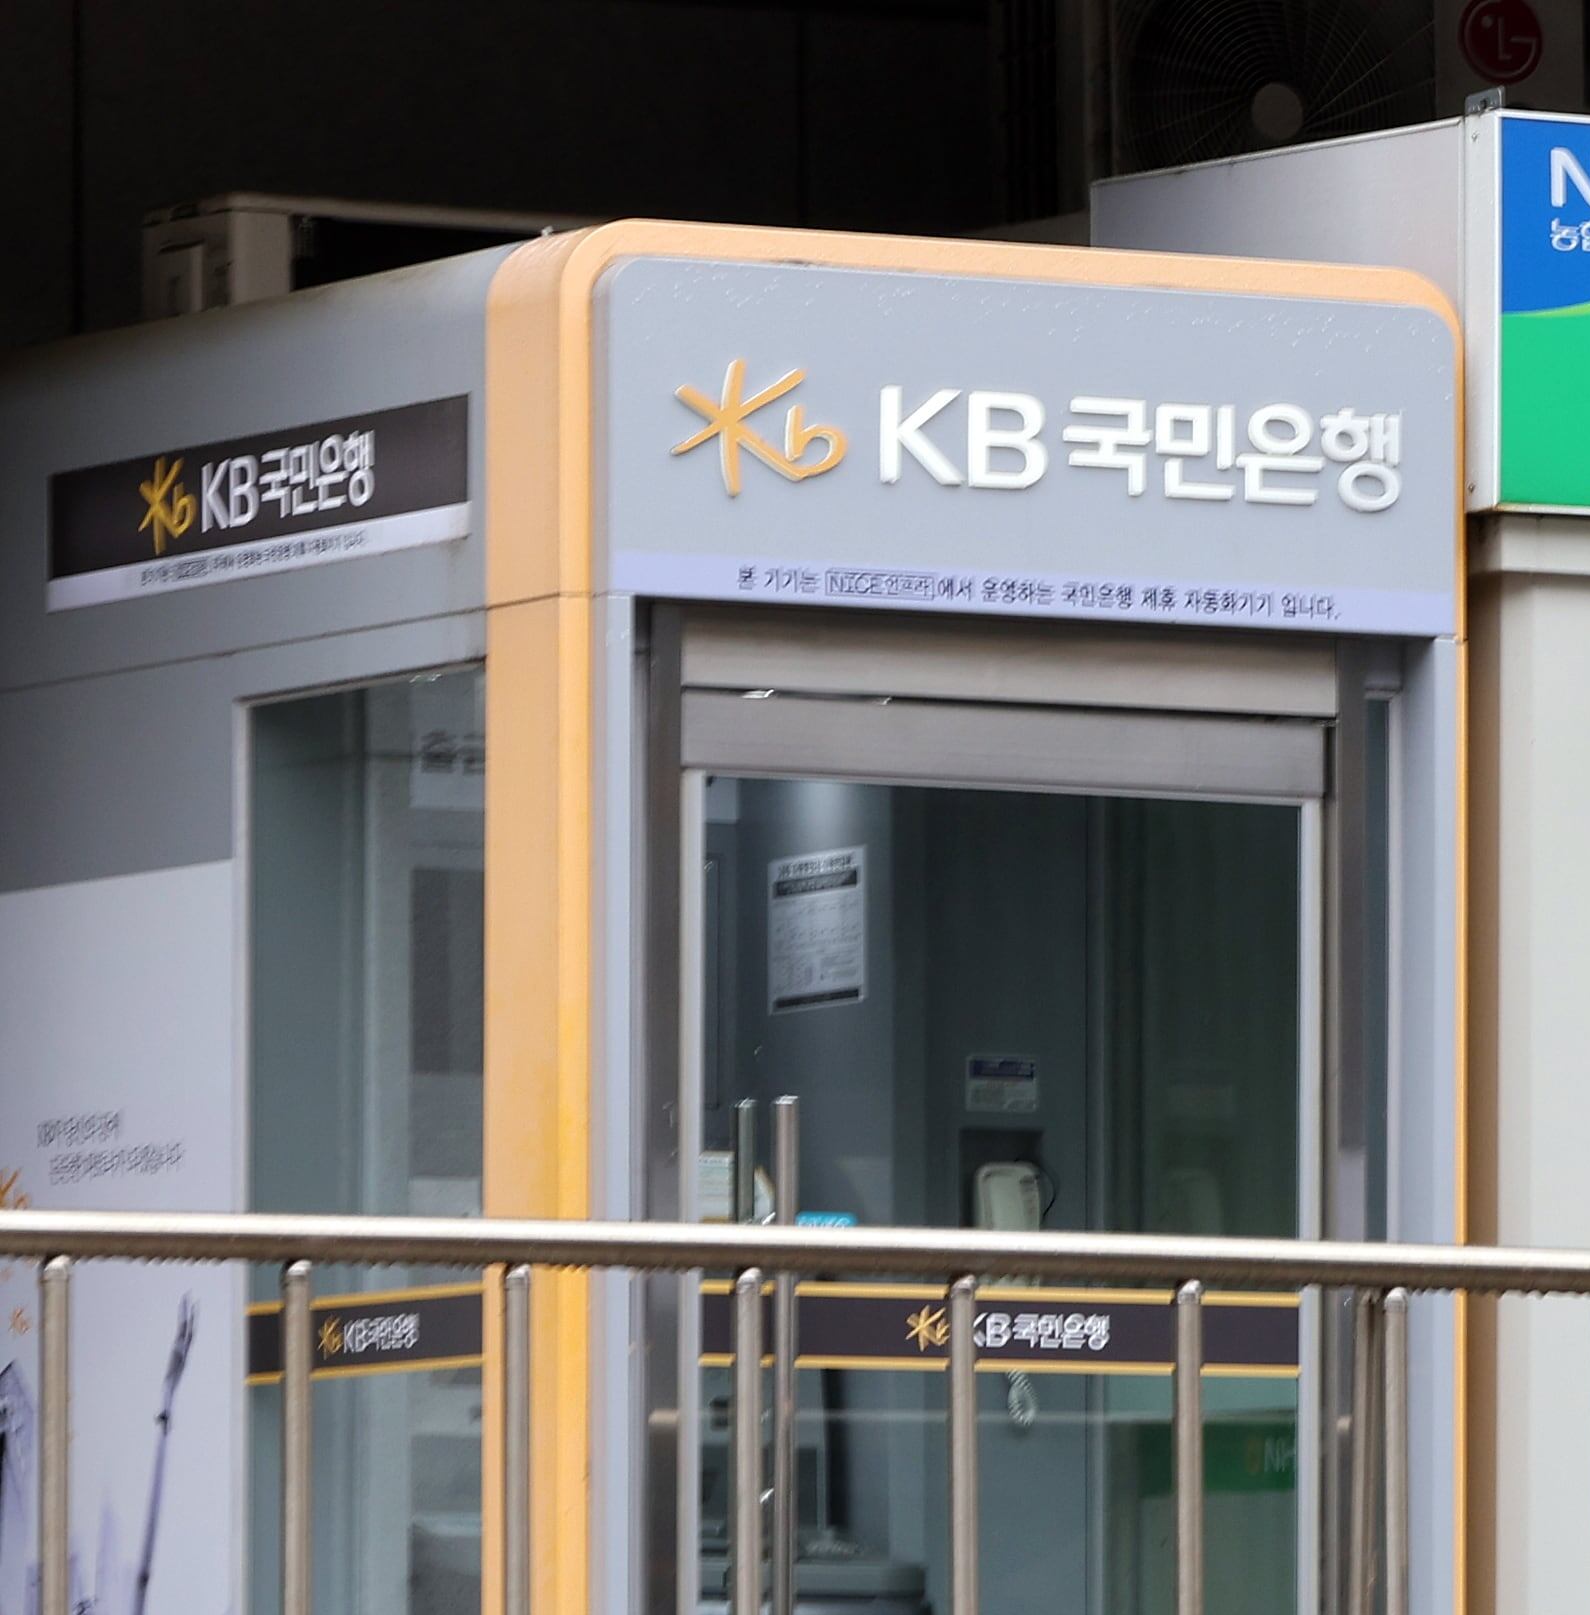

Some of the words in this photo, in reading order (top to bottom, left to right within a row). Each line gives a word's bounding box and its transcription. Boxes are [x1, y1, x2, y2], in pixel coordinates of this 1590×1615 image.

[201, 430, 375, 534] KB국민은행
[879, 384, 1404, 513] KB국민은행
[739, 565, 755, 591] 본
[764, 569, 818, 595] 기기는
[981, 576, 1057, 605] 운영하는
[1061, 581, 1133, 610] 국민은행
[1141, 585, 1176, 612] 제휴
